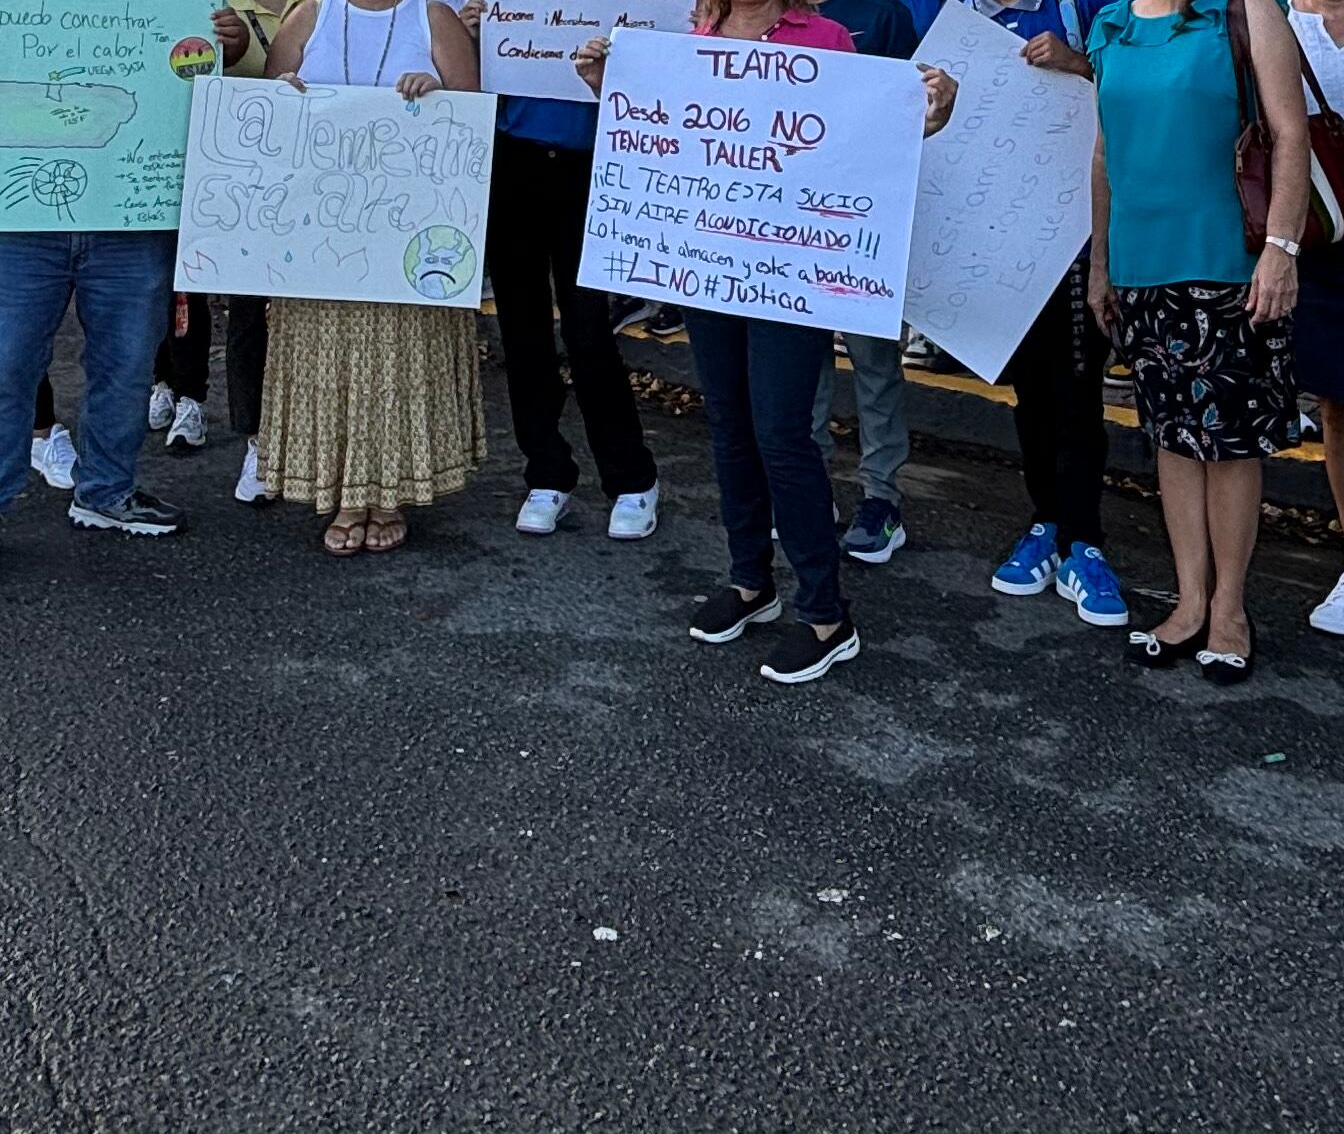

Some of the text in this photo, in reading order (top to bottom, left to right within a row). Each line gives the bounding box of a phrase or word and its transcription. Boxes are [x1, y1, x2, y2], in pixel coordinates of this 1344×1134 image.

[22, 33, 58, 59] Por
[65, 34, 81, 59] el
[696, 48, 819, 86] TEATRO
[607, 91, 827, 146] Desde 2016 NO
[699, 137, 784, 173] TALLER
[638, 166, 721, 203] TEATRO
[725, 180, 784, 204] ESTA
[797, 187, 874, 213] SUCIO
[636, 203, 690, 225] AIRE
[587, 215, 607, 238] Lo
[609, 221, 652, 252] tienen
[656, 233, 672, 256] de
[677, 241, 735, 270] almacen
[742, 259, 752, 279] y
